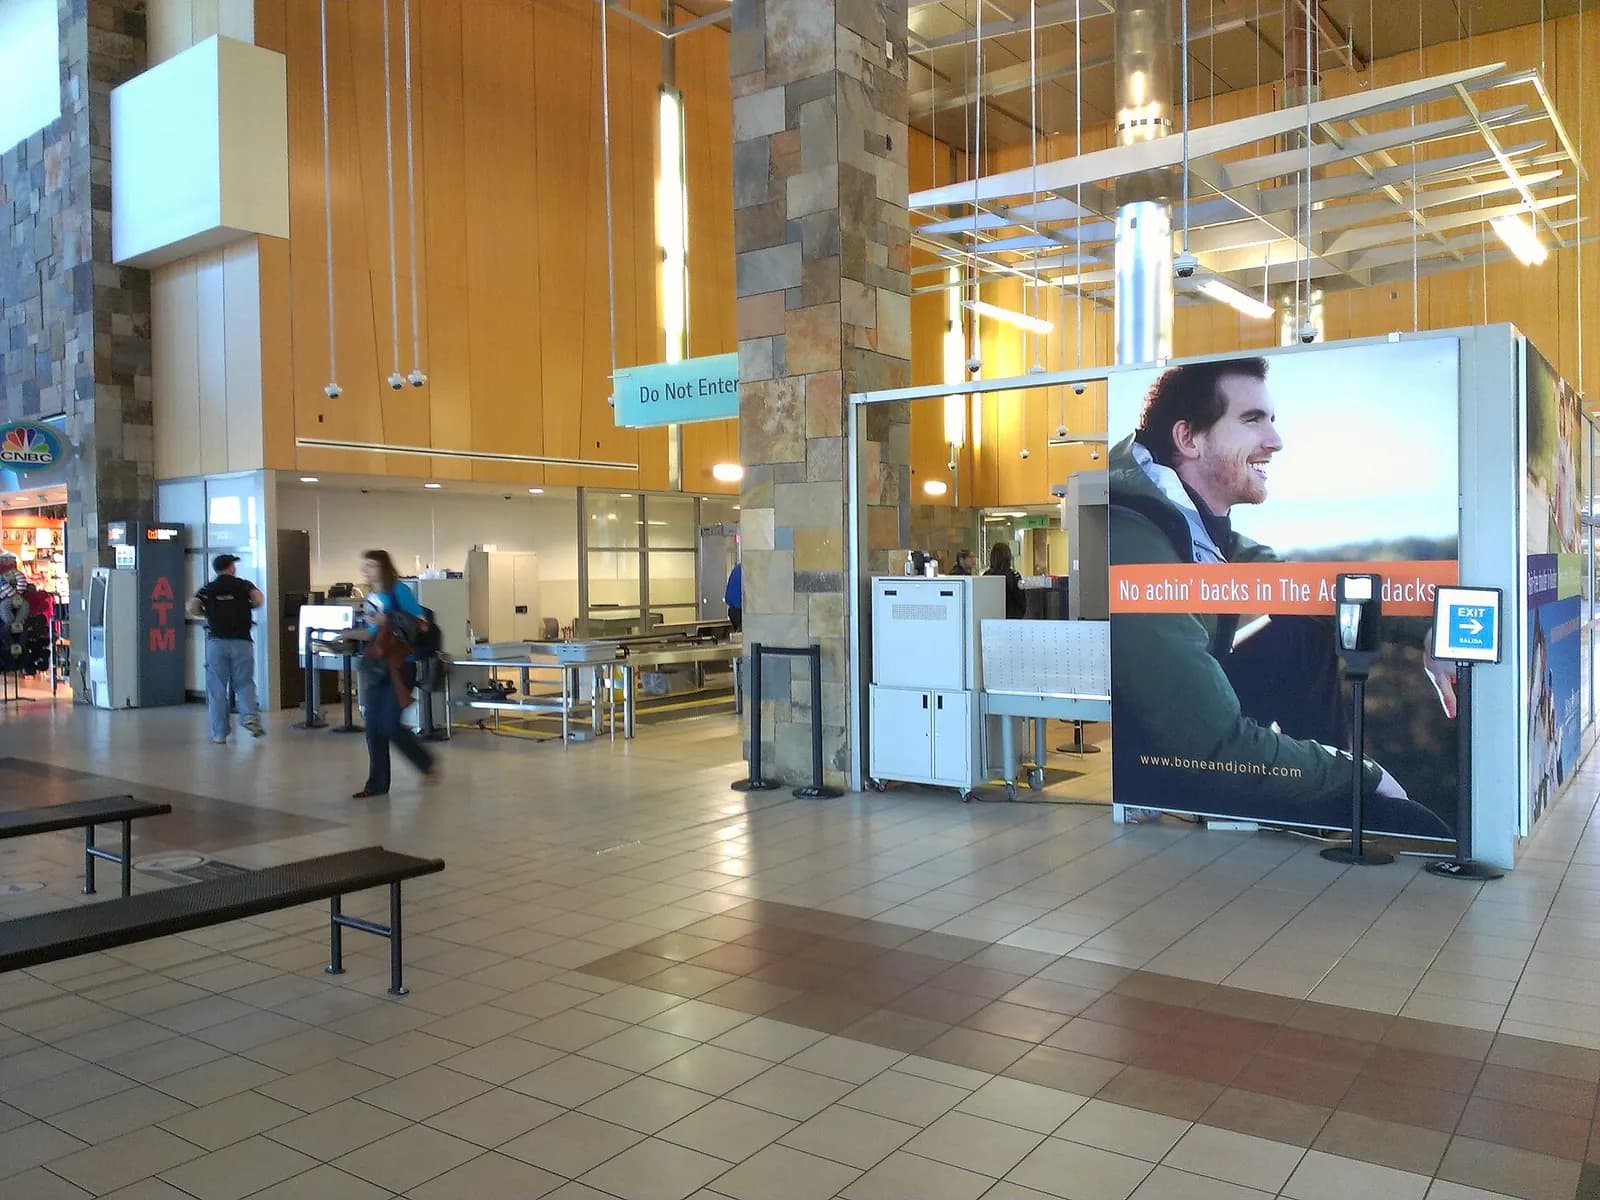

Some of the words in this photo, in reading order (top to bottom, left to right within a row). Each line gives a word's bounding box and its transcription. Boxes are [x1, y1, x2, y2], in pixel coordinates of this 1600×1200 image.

[640, 386, 659, 403] Do
[665, 382, 692, 401] Not
[699, 377, 739, 396] Enter
[1, 451, 52, 463] CNBC
[1119, 579, 1139, 600] No
[1145, 578, 1193, 600] achin'
[1200, 578, 1249, 600] backs
[1256, 578, 1272, 600] in
[1278, 578, 1311, 601] The
[149, 575, 176, 651] ATM
[1457, 607, 1486, 618] EXIT
[1459, 637, 1483, 646] SALIDA
[1140, 754, 1302, 778] www.boneandjoint.com
